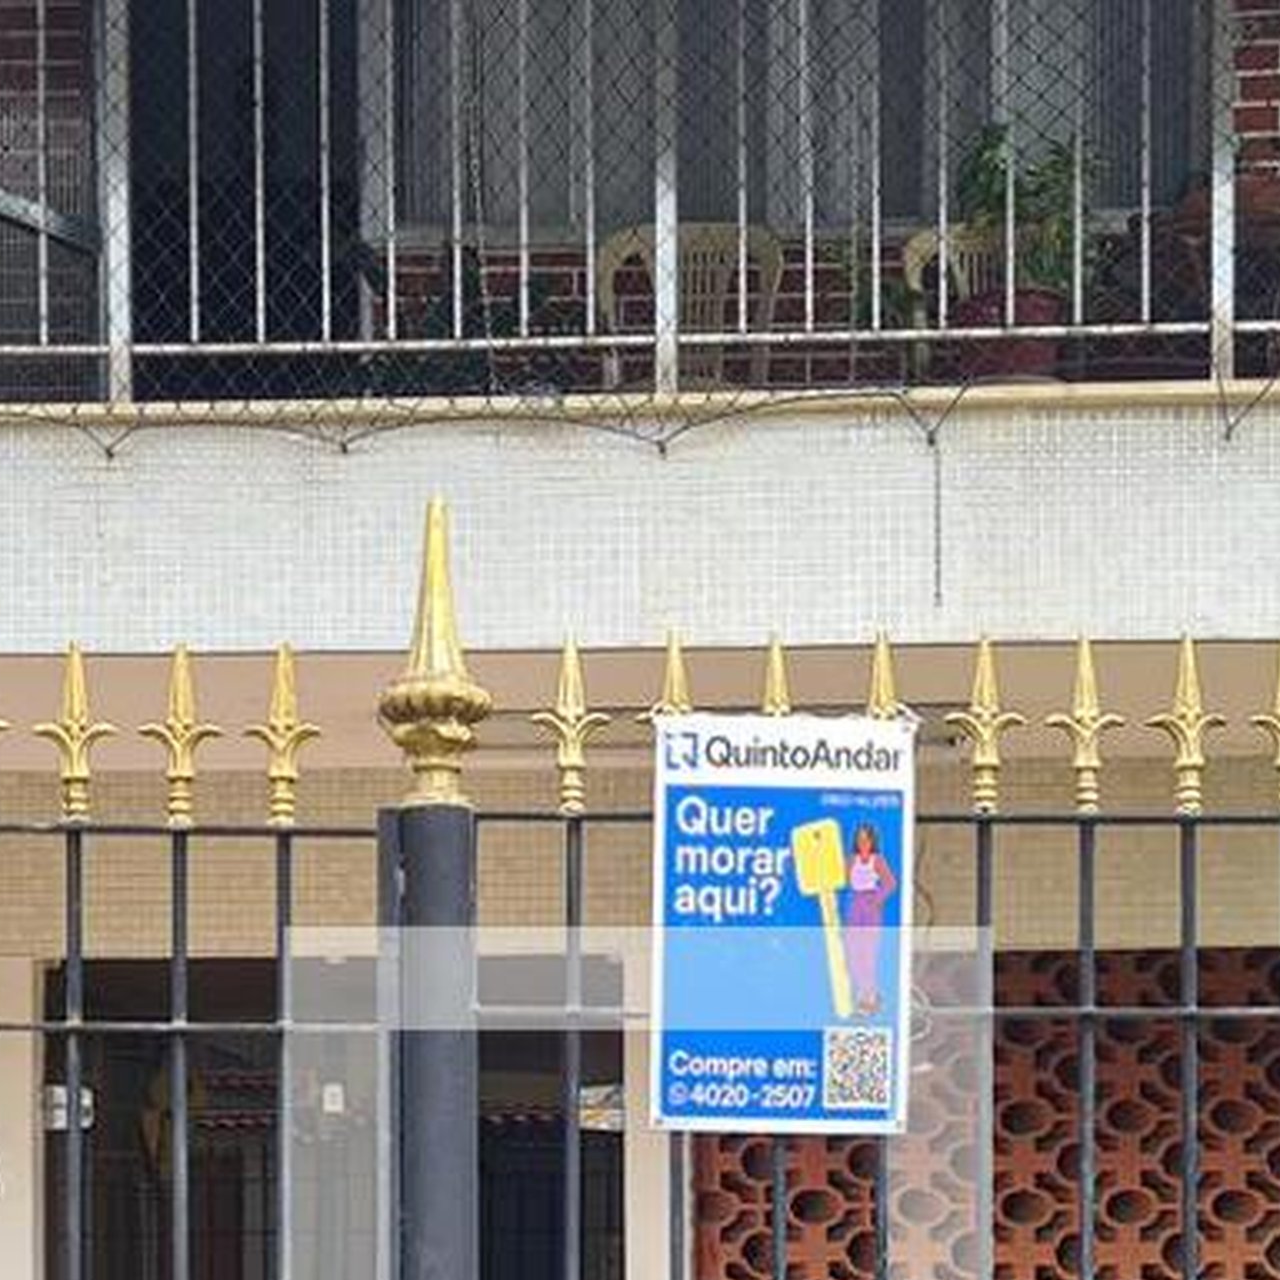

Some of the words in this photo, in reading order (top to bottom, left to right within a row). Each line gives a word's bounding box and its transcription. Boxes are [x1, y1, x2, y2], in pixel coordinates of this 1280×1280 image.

[705, 735, 901, 771] QuintoAndar
[675, 795, 775, 836] Quer
[675, 845, 792, 876] morar
[674, 876, 782, 923] aqui?
[669, 1049, 769, 1080] Compre
[773, 1056, 817, 1079] em:
[690, 1082, 817, 1109] 4020-2507
